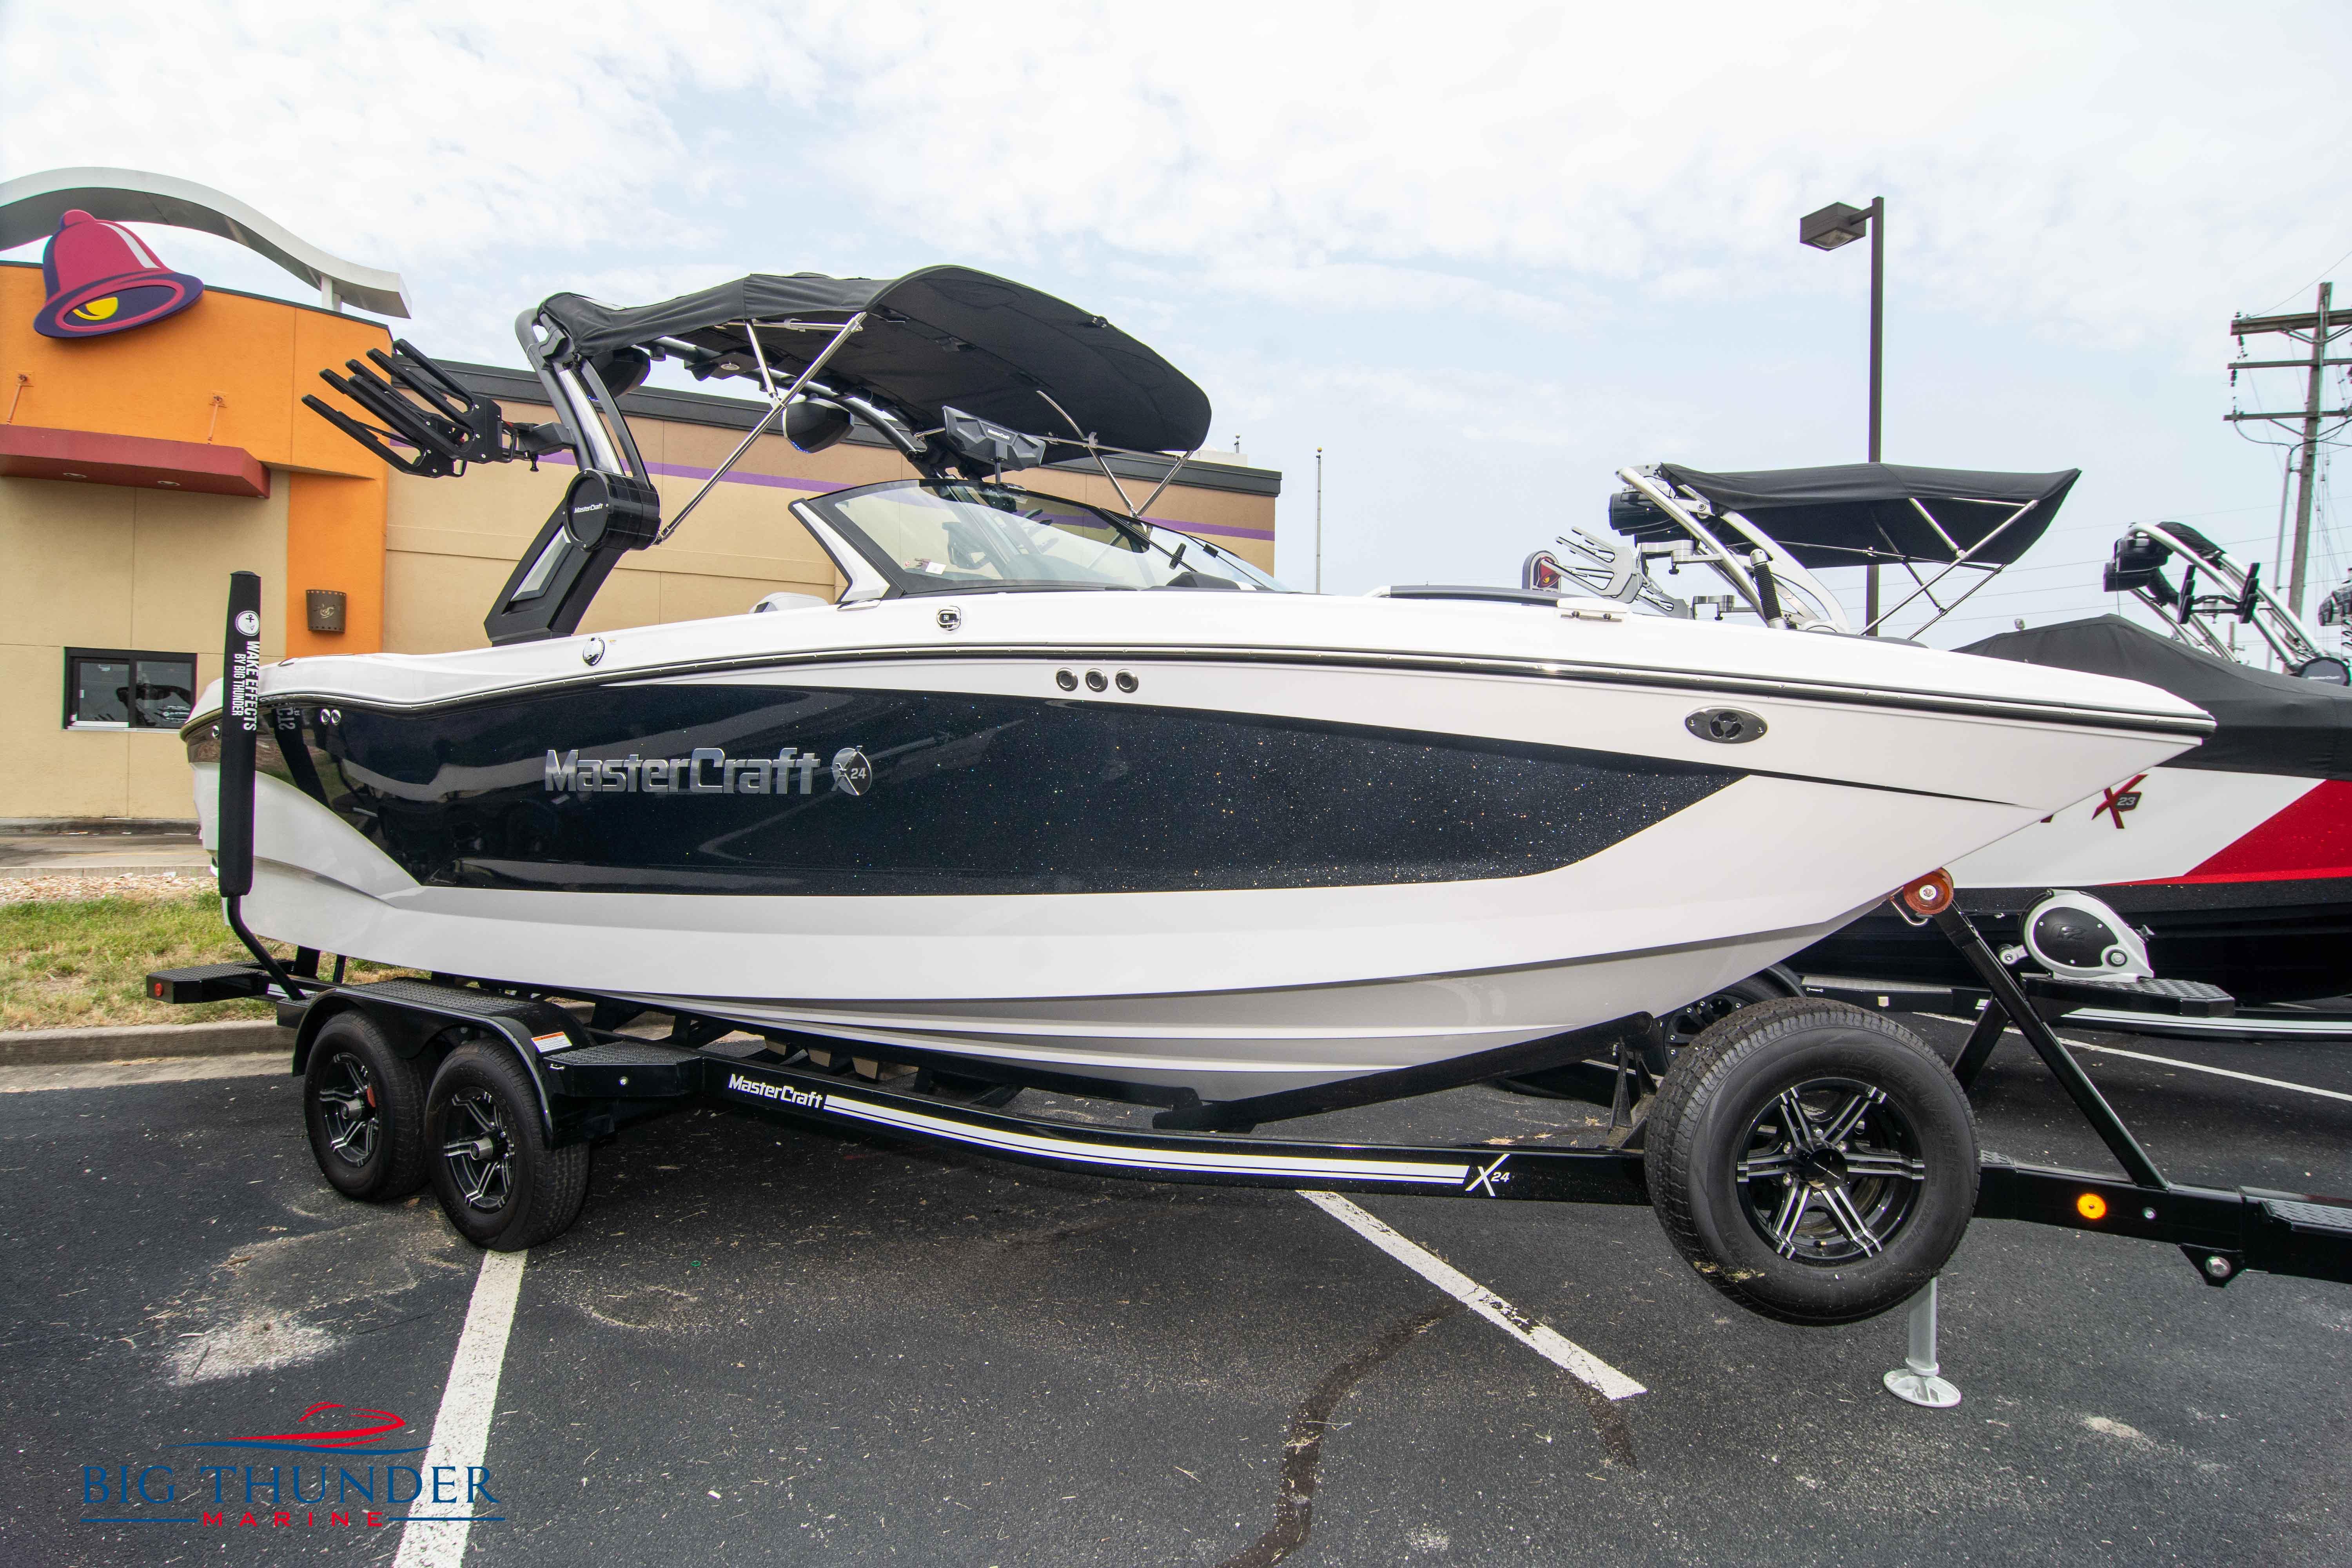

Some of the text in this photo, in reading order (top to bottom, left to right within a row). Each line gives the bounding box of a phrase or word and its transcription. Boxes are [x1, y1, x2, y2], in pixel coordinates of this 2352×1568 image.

[574, 503, 603, 514] MasterCraft
[232, 653, 246, 716] BY BIG THUNDER
[243, 641, 260, 731] WAKE EFFECTS
[544, 747, 820, 795] MasterCraft
[728, 1073, 823, 1109] MasterCraft
